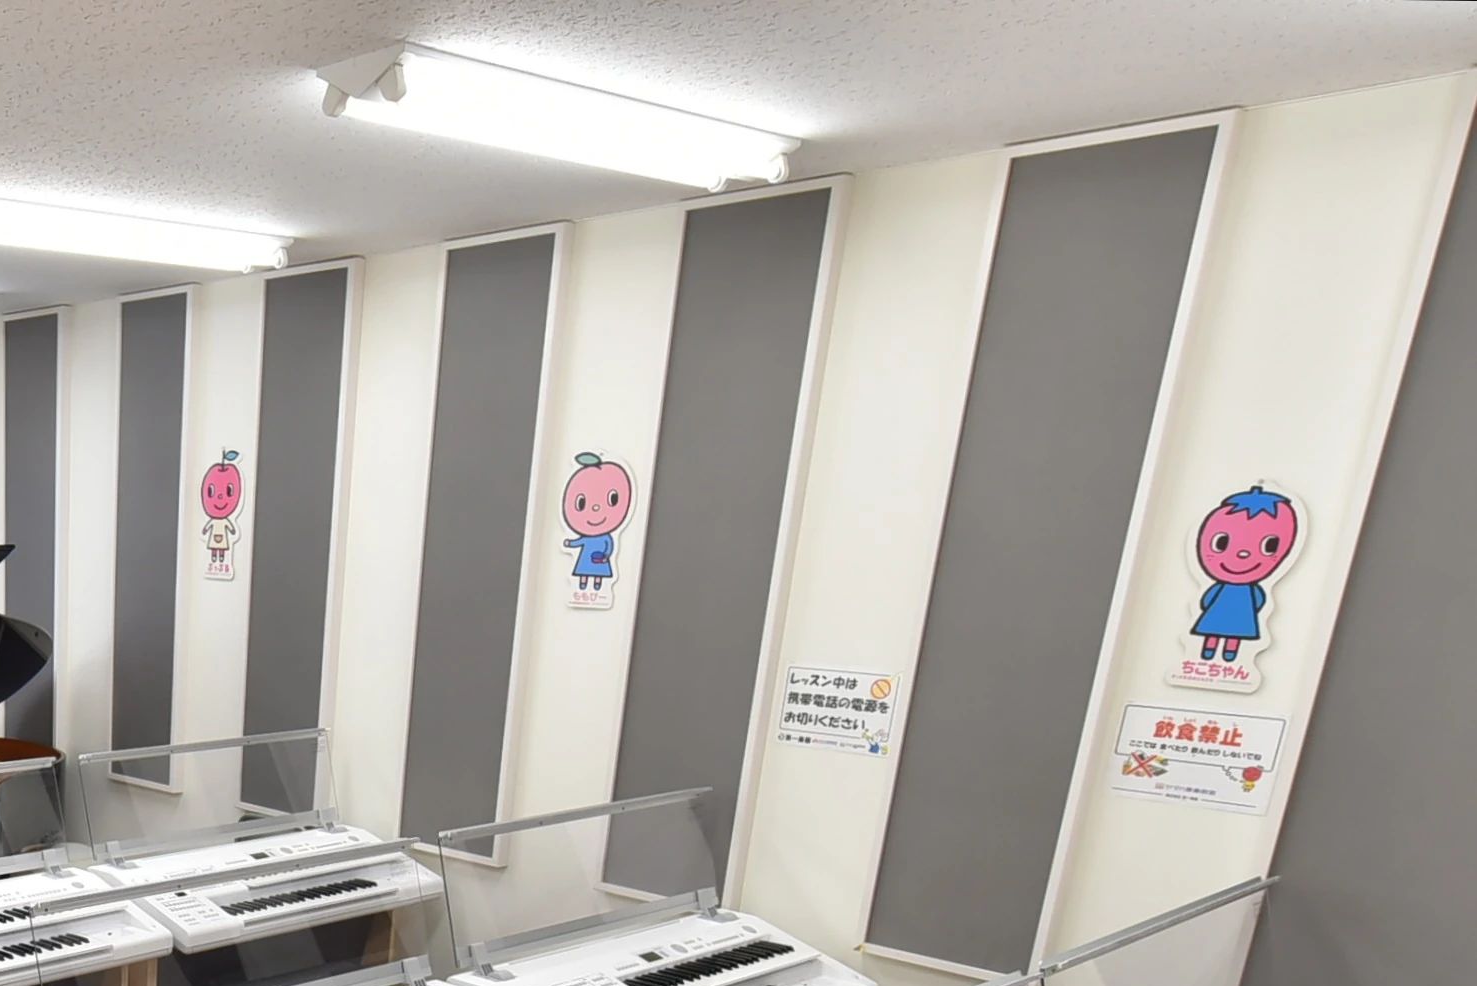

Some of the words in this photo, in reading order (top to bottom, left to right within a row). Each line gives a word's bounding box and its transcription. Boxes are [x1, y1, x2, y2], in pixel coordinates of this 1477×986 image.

[1182, 660, 1250, 680] ちこちゃん
[790, 672, 858, 690] レッスン中は
[787, 692, 890, 714] 携帯電話の電源を
[1153, 720, 1243, 747] 飲食禁止
